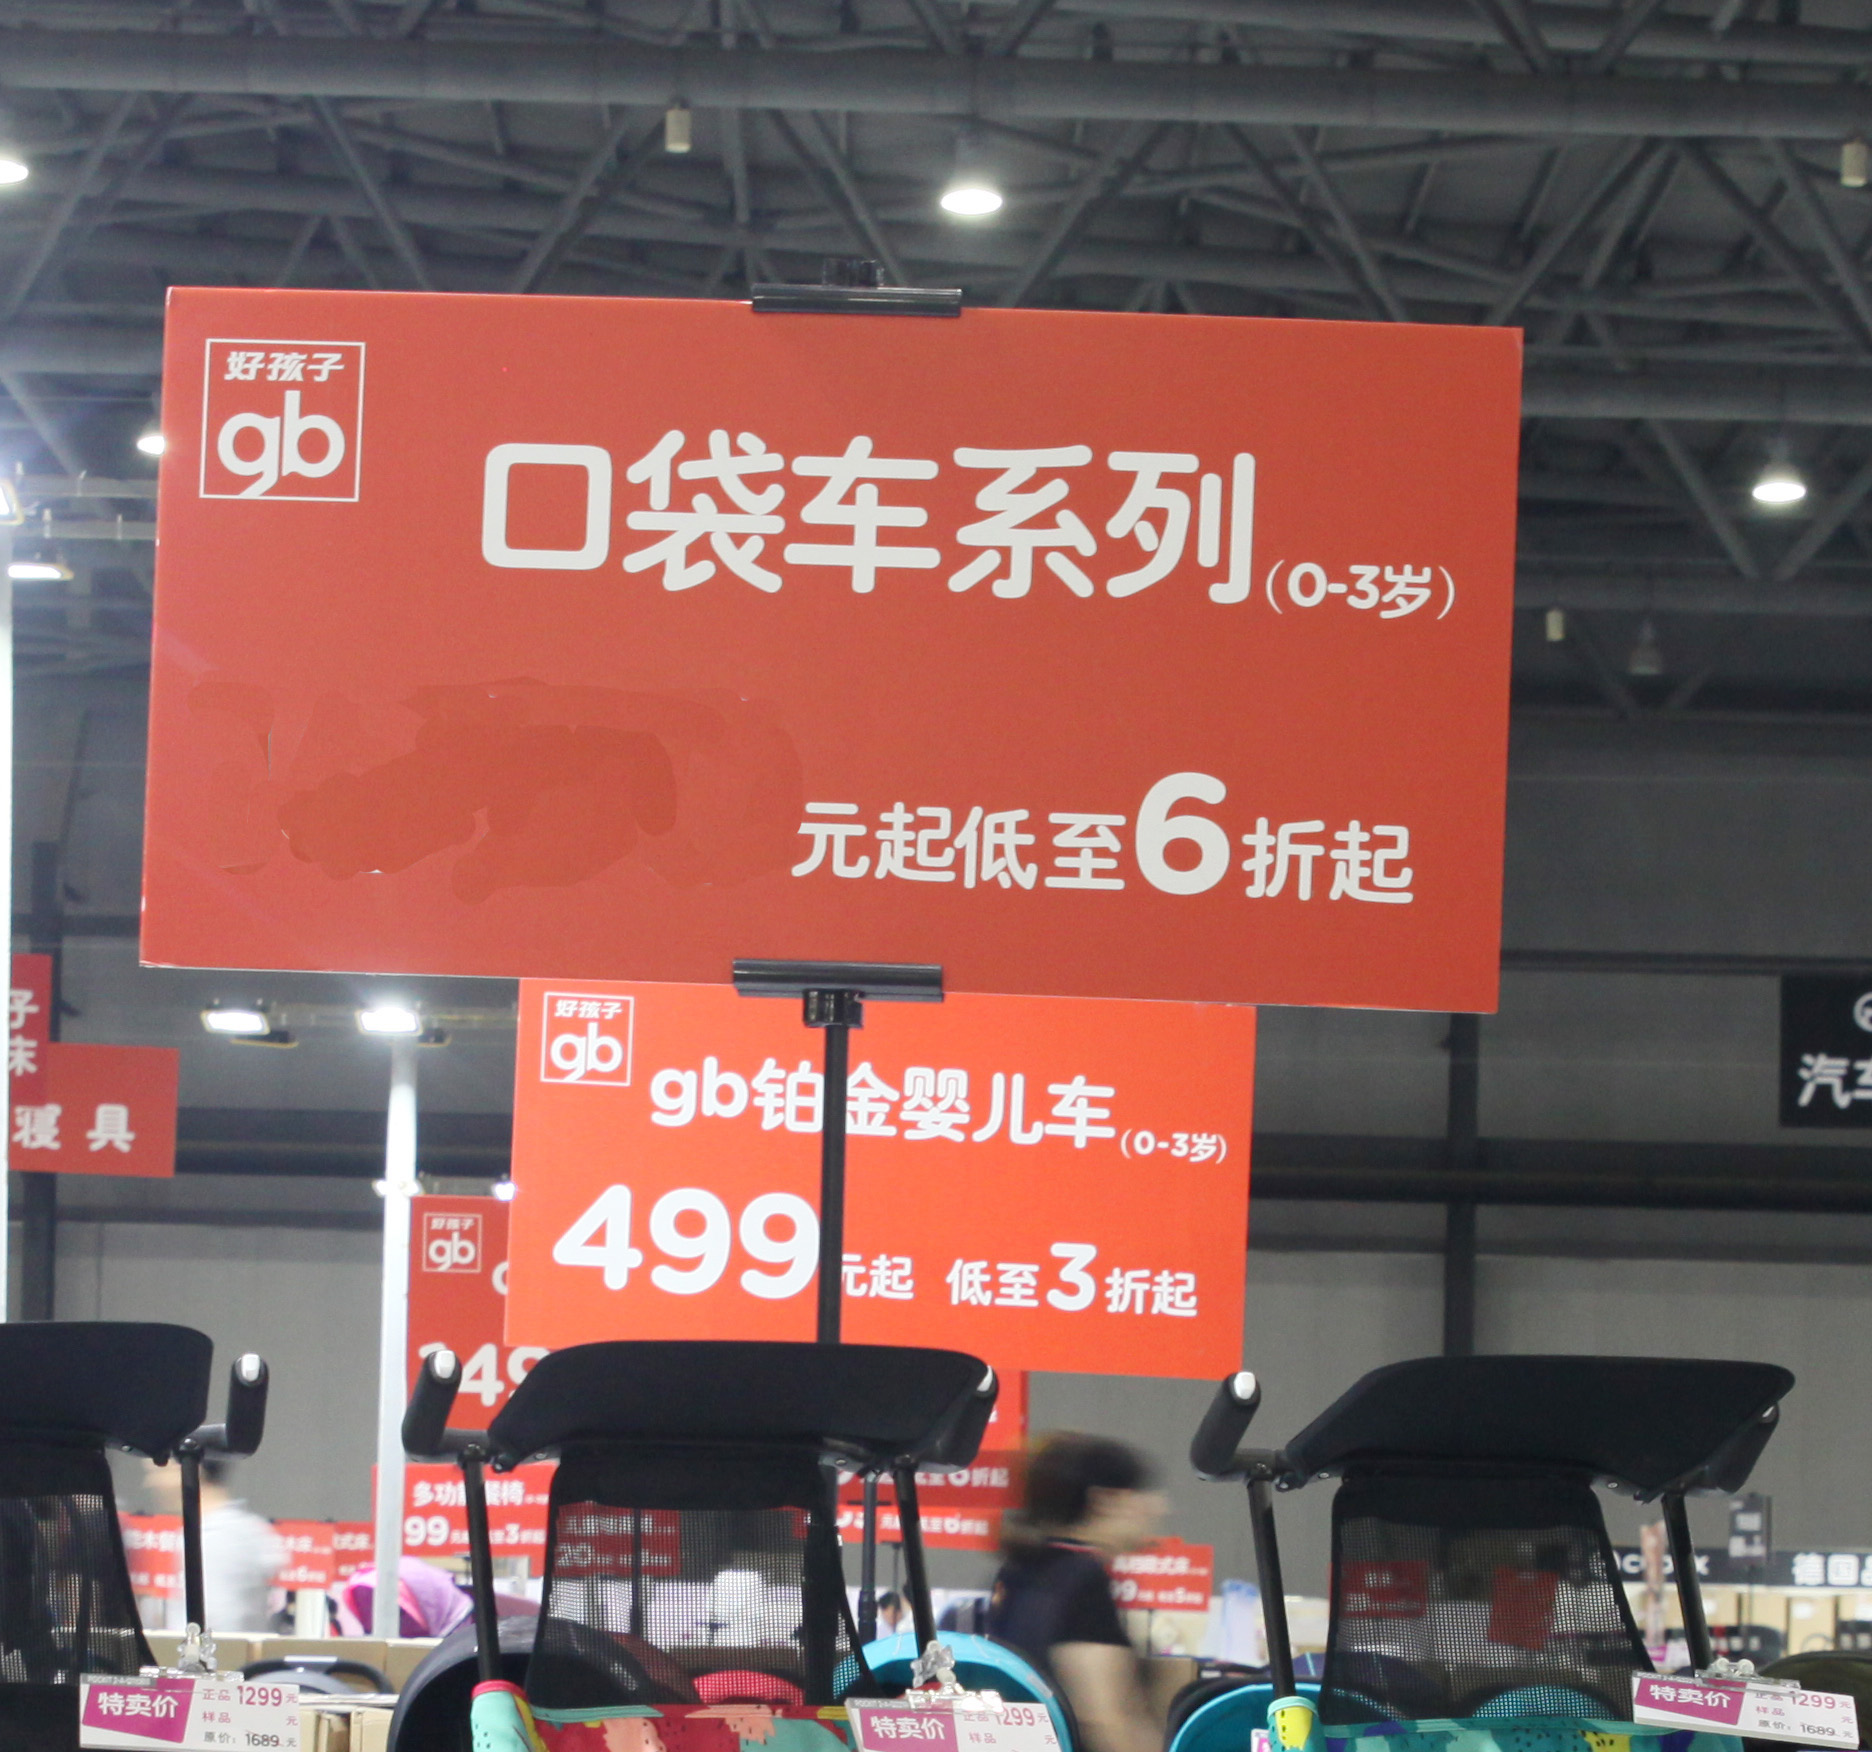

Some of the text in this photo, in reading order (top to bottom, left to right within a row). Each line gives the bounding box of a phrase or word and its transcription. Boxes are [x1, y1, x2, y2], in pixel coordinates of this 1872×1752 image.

[224, 349, 344, 383] 好孩子
[215, 388, 345, 498] gb
[481, 429, 1256, 604] 口袋车系列
[554, 1000, 623, 1019] 好孩子
[550, 1021, 623, 1082] gb
[428, 1231, 476, 1272] gb
[97, 1692, 179, 1719] 特卖价
[202, 1688, 231, 1701] 正品
[236, 1685, 283, 1707] 1299
[1648, 1684, 1732, 1709] 特卖价
[1790, 1692, 1837, 1710] 1299
[201, 1711, 231, 1723] 样品
[869, 1715, 945, 1740] 特卖价
[1800, 1723, 1836, 1736] 1689
[245, 1733, 280, 1747] 1689
